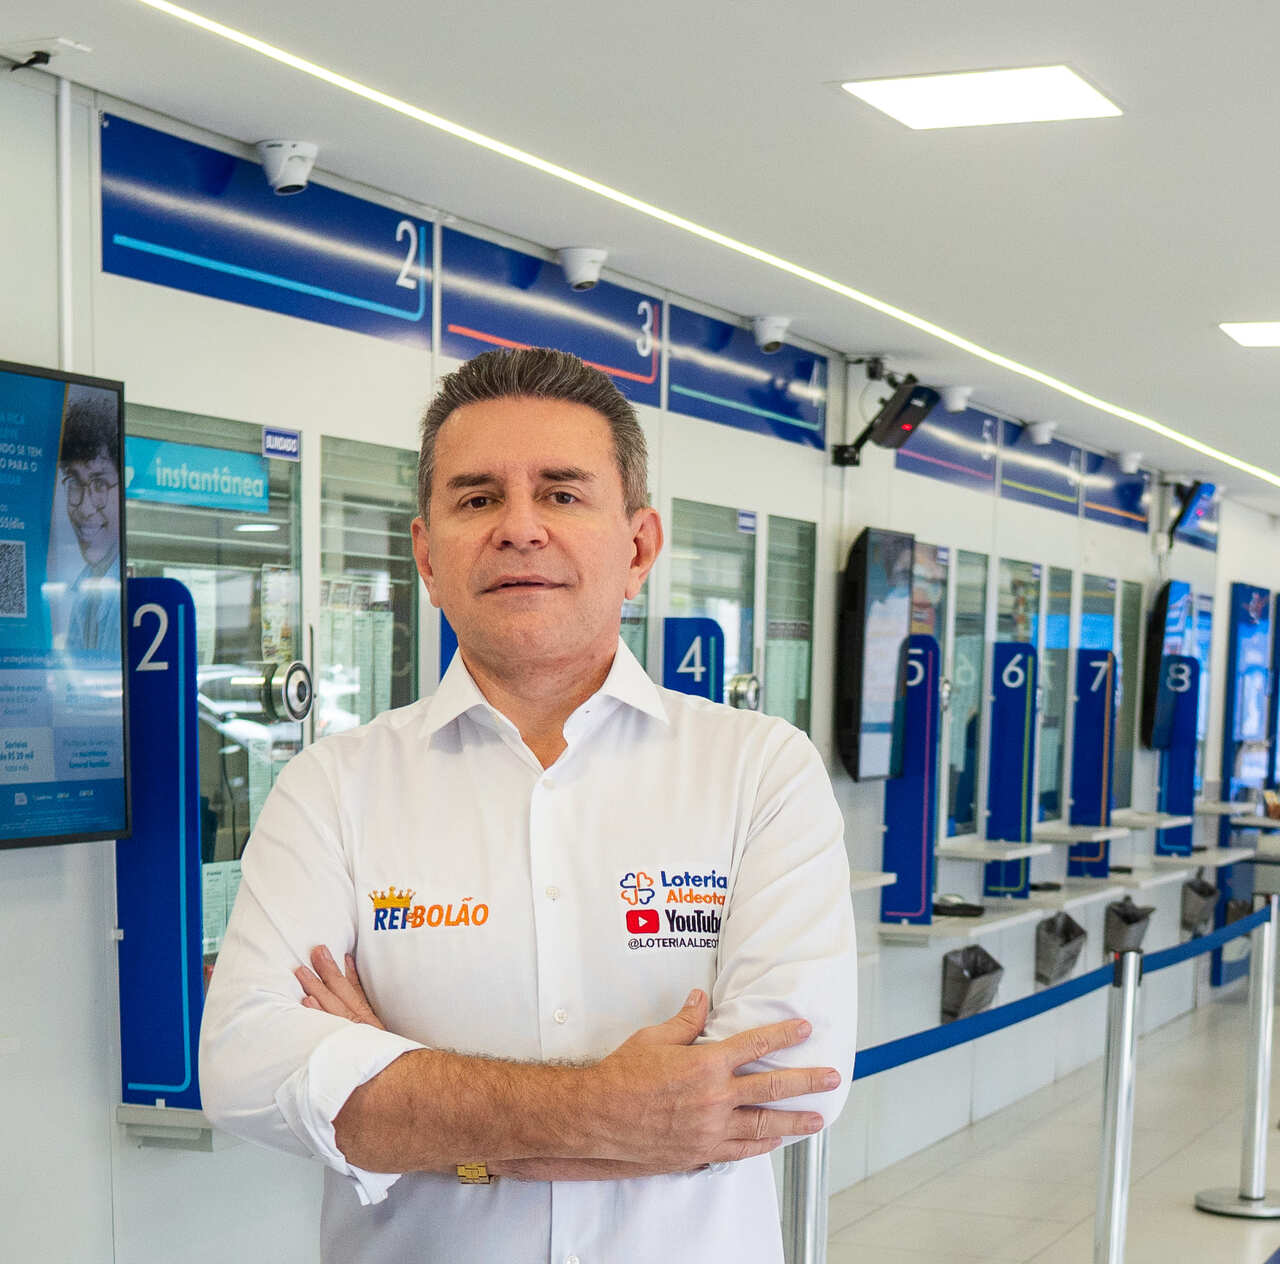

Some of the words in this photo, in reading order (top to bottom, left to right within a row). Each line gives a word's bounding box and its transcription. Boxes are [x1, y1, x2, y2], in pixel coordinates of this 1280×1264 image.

[395, 220, 419, 290] 2
[636, 300, 654, 358] 3
[8, 459, 29, 471] PARA
[155, 456, 265, 498] instantânea
[132, 602, 170, 672] 2
[676, 635, 707, 683] 4
[906, 648, 925, 687] 5
[1002, 653, 1025, 689] 6
[1089, 660, 1109, 692] 7
[1166, 663, 1192, 693] 8
[660, 869, 728, 889] Loteria
[666, 887, 726, 906] Aldeota
[373, 907, 410, 931] REI
[410, 896, 489, 929] BOLÃO
